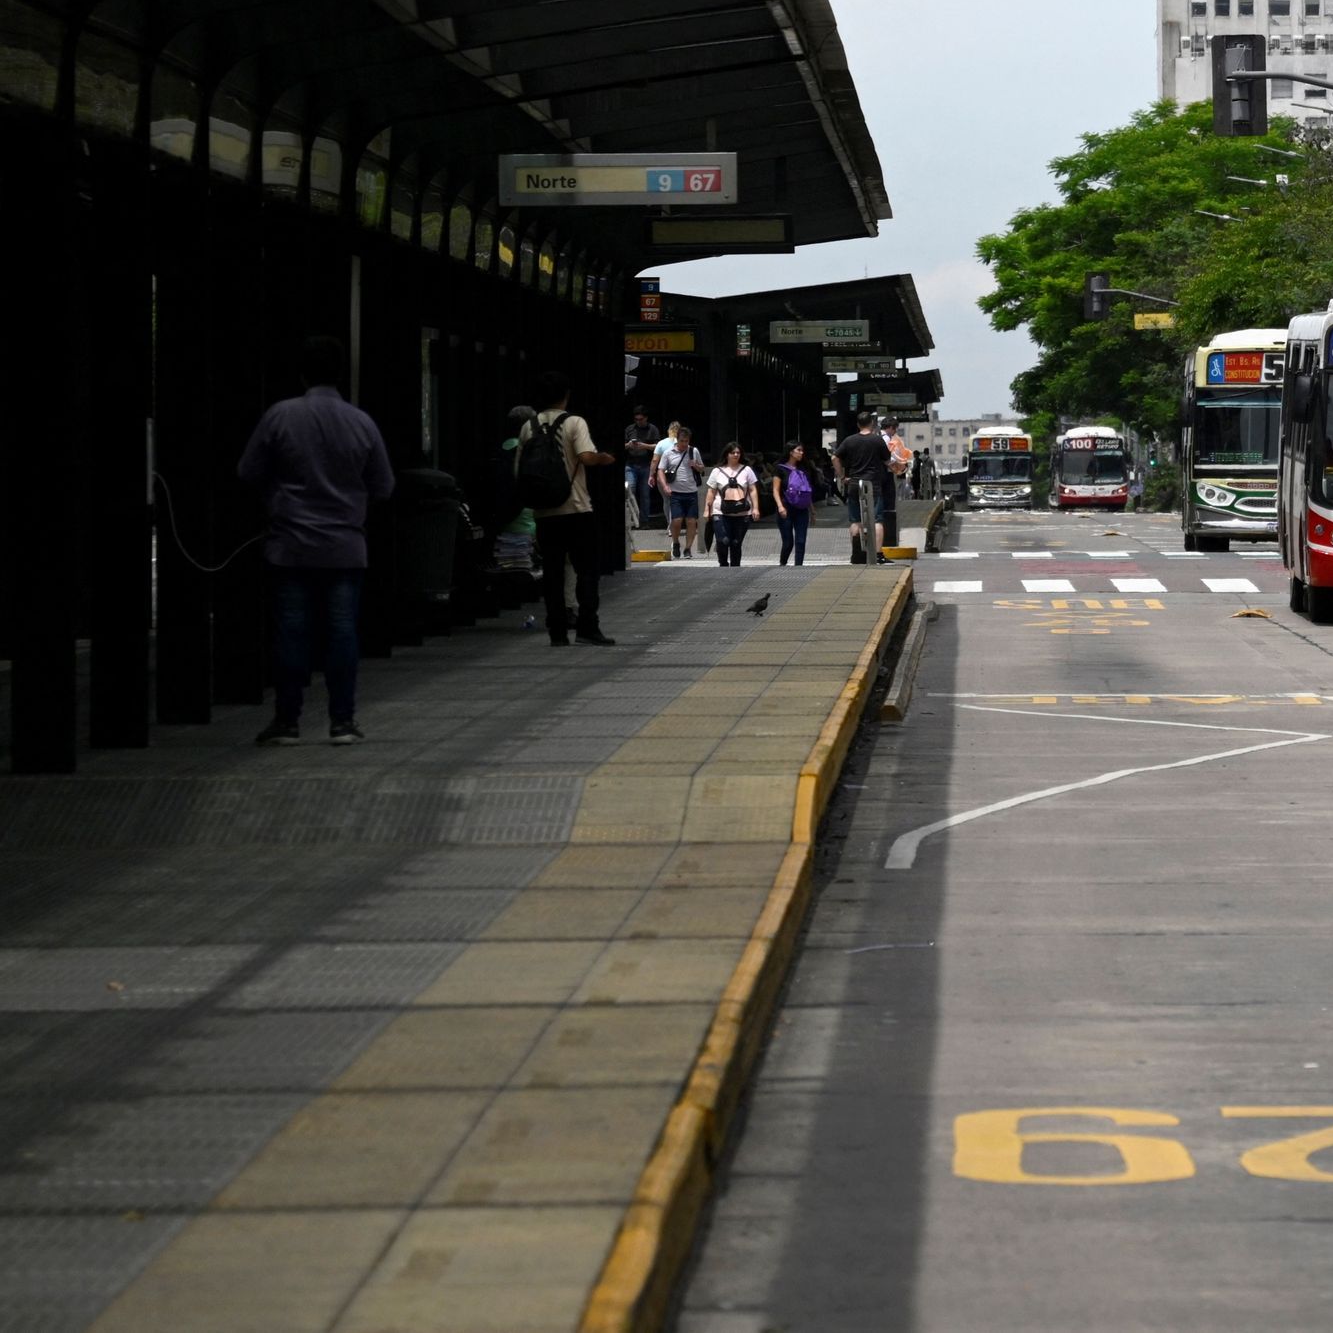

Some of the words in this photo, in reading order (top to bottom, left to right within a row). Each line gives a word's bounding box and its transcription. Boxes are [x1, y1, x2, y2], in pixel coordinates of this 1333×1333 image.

[526, 174, 577, 189] Norte
[658, 174, 672, 192] 9
[689, 173, 715, 192] 67
[645, 297, 656, 306] 67
[643, 312, 658, 321] 129
[780, 327, 803, 336] Norte
[993, 439, 1008, 449] 59
[1070, 439, 1092, 450] 100
[992, 598, 1167, 610] BUS
